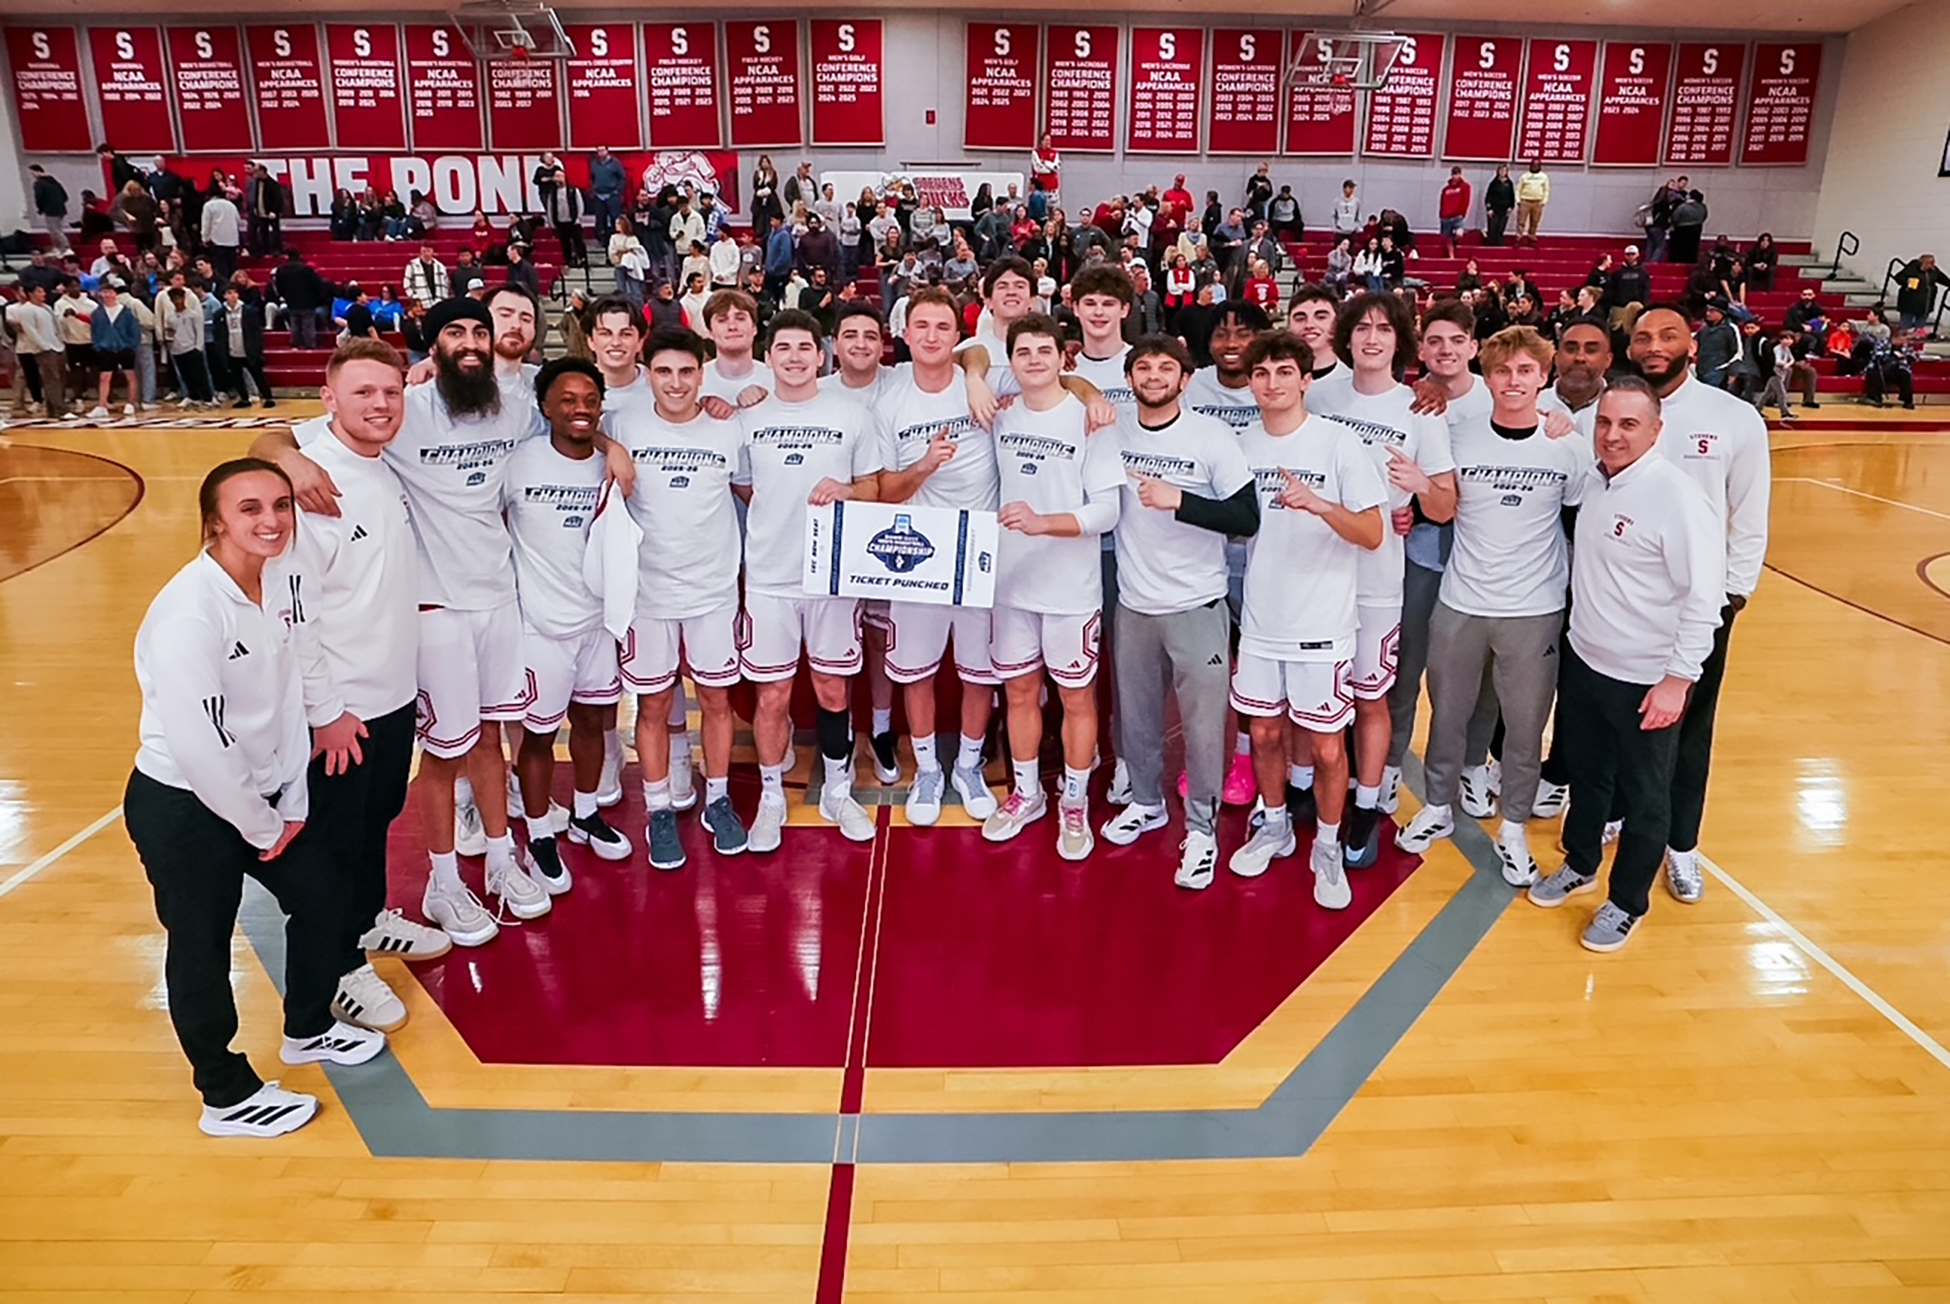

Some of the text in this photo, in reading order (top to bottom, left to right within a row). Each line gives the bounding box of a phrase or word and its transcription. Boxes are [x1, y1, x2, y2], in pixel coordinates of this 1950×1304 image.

[274, 30, 291, 56] S
[354, 30, 370, 56] S
[591, 29, 608, 56] S
[671, 28, 688, 55] S
[754, 26, 770, 53] S
[838, 24, 854, 52] S
[995, 29, 1011, 56] S
[32, 31, 50, 59] S
[116, 31, 134, 60] S
[195, 31, 213, 58] S
[432, 30, 449, 57] S
[1075, 31, 1090, 58] S
[1159, 33, 1175, 60] S
[1240, 34, 1255, 61] S
[1317, 38, 1333, 62] S
[1400, 37, 1416, 65] S
[1479, 42, 1495, 69] S
[1554, 44, 1570, 71] S
[1629, 48, 1645, 74] S
[1703, 48, 1719, 74] S
[1780, 49, 1796, 75] S
[335, 68, 394, 78] CONFERENCE
[492, 69, 551, 78] CONFERENCE
[585, 68, 616, 78] NCAA
[651, 67, 711, 76] CONFERENCE
[748, 65, 779, 75] NCAA
[817, 64, 877, 73] CONFERENCE
[986, 67, 1017, 77] NCAA
[113, 71, 145, 81] NCAA
[178, 70, 238, 80] CONFERENCE
[271, 69, 302, 79] NCAA
[427, 69, 458, 79] NCAA
[817, 73, 877, 83] CHAMPIONS
[1052, 69, 1111, 79] CONFERENCE
[1150, 72, 1180, 81] NCAA
[1216, 73, 1275, 82] CONFERENCE
[259, 79, 318, 88] APPEARANCES
[335, 79, 395, 88] CHAMPIONS
[414, 80, 473, 88] APPEARANCES
[492, 79, 552, 88] CHAMPIONS
[573, 79, 632, 88] APPEARANCES
[651, 76, 712, 86] CHAMPIONS
[734, 75, 794, 85] APPEARANCES
[971, 78, 1031, 87] APPEARANCES
[1051, 80, 1111, 89] CHAMPIONS
[1456, 80, 1513, 90] CONFERENCE
[179, 81, 239, 90] CHAMPIONS
[1136, 82, 1195, 91] APPEARANCES
[1216, 83, 1275, 92] CHAMPIONS
[1544, 83, 1572, 93] NCAA
[1455, 89, 1512, 100] CHAMPIONS
[1618, 86, 1646, 96] NCAA
[1678, 87, 1735, 95] CONFERENCE
[1768, 87, 1797, 96] NCAA
[1529, 93, 1586, 102] APPEARANCES
[1604, 97, 1660, 105] APPEARANCES
[1677, 95, 1733, 104] CHAMPIONS
[1754, 97, 1810, 105] APPEARANCES
[752, 430, 843, 445] CHAMPIONS
[420, 440, 514, 465] CHAMPIONS
[1000, 435, 1075, 461] CHAMPIONS
[1698, 440, 1709, 455] S
[631, 449, 726, 469] CHAMPIONS
[1461, 467, 1567, 488] CHAMPIONS
[525, 488, 599, 505] CHAMPIO
[1614, 521, 1625, 537] S
[868, 543, 935, 557] CHAMPIONSHIP
[850, 575, 950, 591] TICKET PUNCHED
